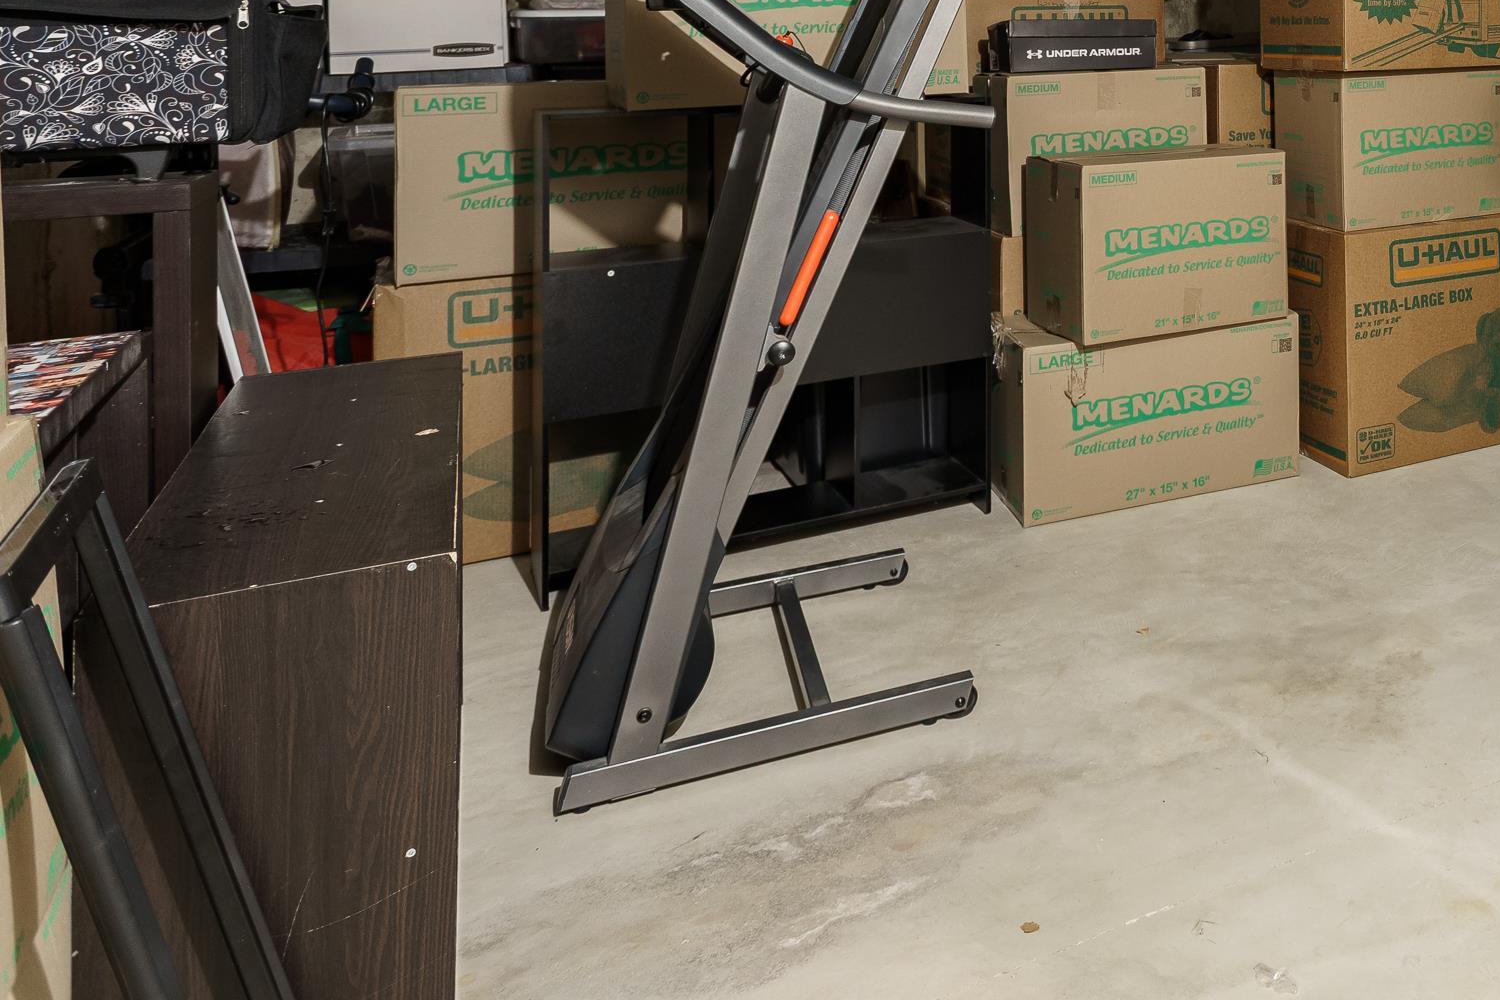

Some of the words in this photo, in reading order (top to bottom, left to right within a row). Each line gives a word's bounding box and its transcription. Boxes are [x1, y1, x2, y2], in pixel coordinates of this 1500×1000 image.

[1367, 0, 1382, 7] time
[1383, 0, 1392, 8] by
[771, 23, 788, 35] to
[792, 20, 845, 35] Service
[1046, 48, 1088, 58] UNDER
[1089, 47, 1142, 57] ARMOUR
[1017, 82, 1060, 95] MEDIUM
[1350, 80, 1385, 90] MEDIUM
[413, 96, 487, 113] LARGE
[1031, 125, 1189, 156] MENARDS
[1228, 129, 1256, 142] Save
[1360, 121, 1495, 155] MENARDS
[1362, 162, 1409, 176] Dedicated
[1411, 161, 1422, 171] to
[1424, 159, 1456, 171] Service
[1458, 157, 1465, 167] &
[1467, 155, 1498, 167] Quality
[1091, 173, 1136, 186] MEDIUM
[459, 193, 533, 211] Dedicate
[549, 192, 566, 205] to
[569, 187, 626, 203] Service
[626, 186, 642, 200] &
[647, 183, 688, 200] Quali
[1401, 209, 1414, 219] 21"
[1423, 207, 1435, 216] 15"
[1105, 215, 1271, 258] MENARDS
[1397, 237, 1496, 268] U-HAUL
[1107, 263, 1165, 281] Dedicated
[1168, 263, 1181, 275] to
[1183, 258, 1222, 273] Service
[1225, 258, 1233, 269] &
[1236, 252, 1276, 267] Quality
[1354, 291, 1445, 318] EXTRA-LARGE
[1449, 287, 1473, 304] BOX
[1154, 317, 1171, 329] 21"
[1182, 314, 1196, 324] 15"
[1354, 330, 1369, 341] 6.0
[1370, 328, 1382, 338] CU
[1382, 327, 1393, 336] FT
[1038, 351, 1094, 371] LARGE
[1072, 376, 1252, 432] MENARDS
[1074, 436, 1136, 457] Dedicated
[1139, 433, 1153, 446] to
[1156, 425, 1199, 443] Service
[1202, 423, 1212, 435] &
[1215, 414, 1257, 434] Quality
[1371, 438, 1392, 452] OK
[1126, 486, 1146, 501] 27"
[1149, 487, 1156, 496] x
[1159, 480, 1178, 494] 15"
[1182, 481, 1189, 490] x
[1191, 475, 1211, 489] 16"
